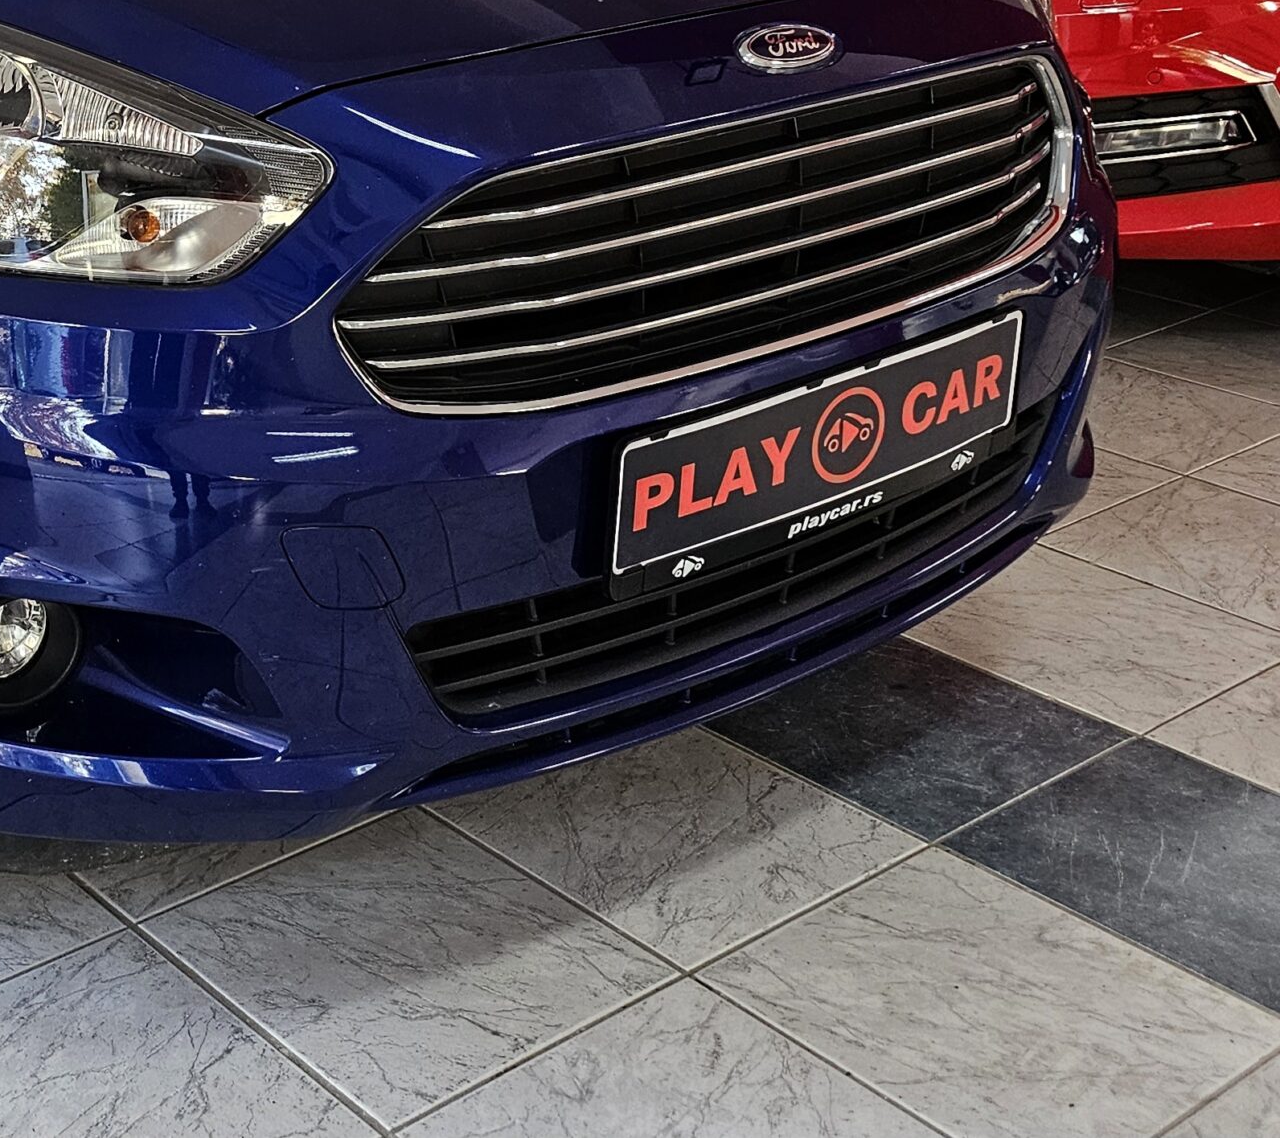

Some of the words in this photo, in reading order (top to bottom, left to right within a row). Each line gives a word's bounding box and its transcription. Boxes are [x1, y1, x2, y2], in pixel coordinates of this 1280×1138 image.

[765, 29, 820, 57] Ford
[632, 428, 801, 532] PLAY
[902, 354, 1003, 435] CAR
[787, 491, 884, 539] playcar.rs
